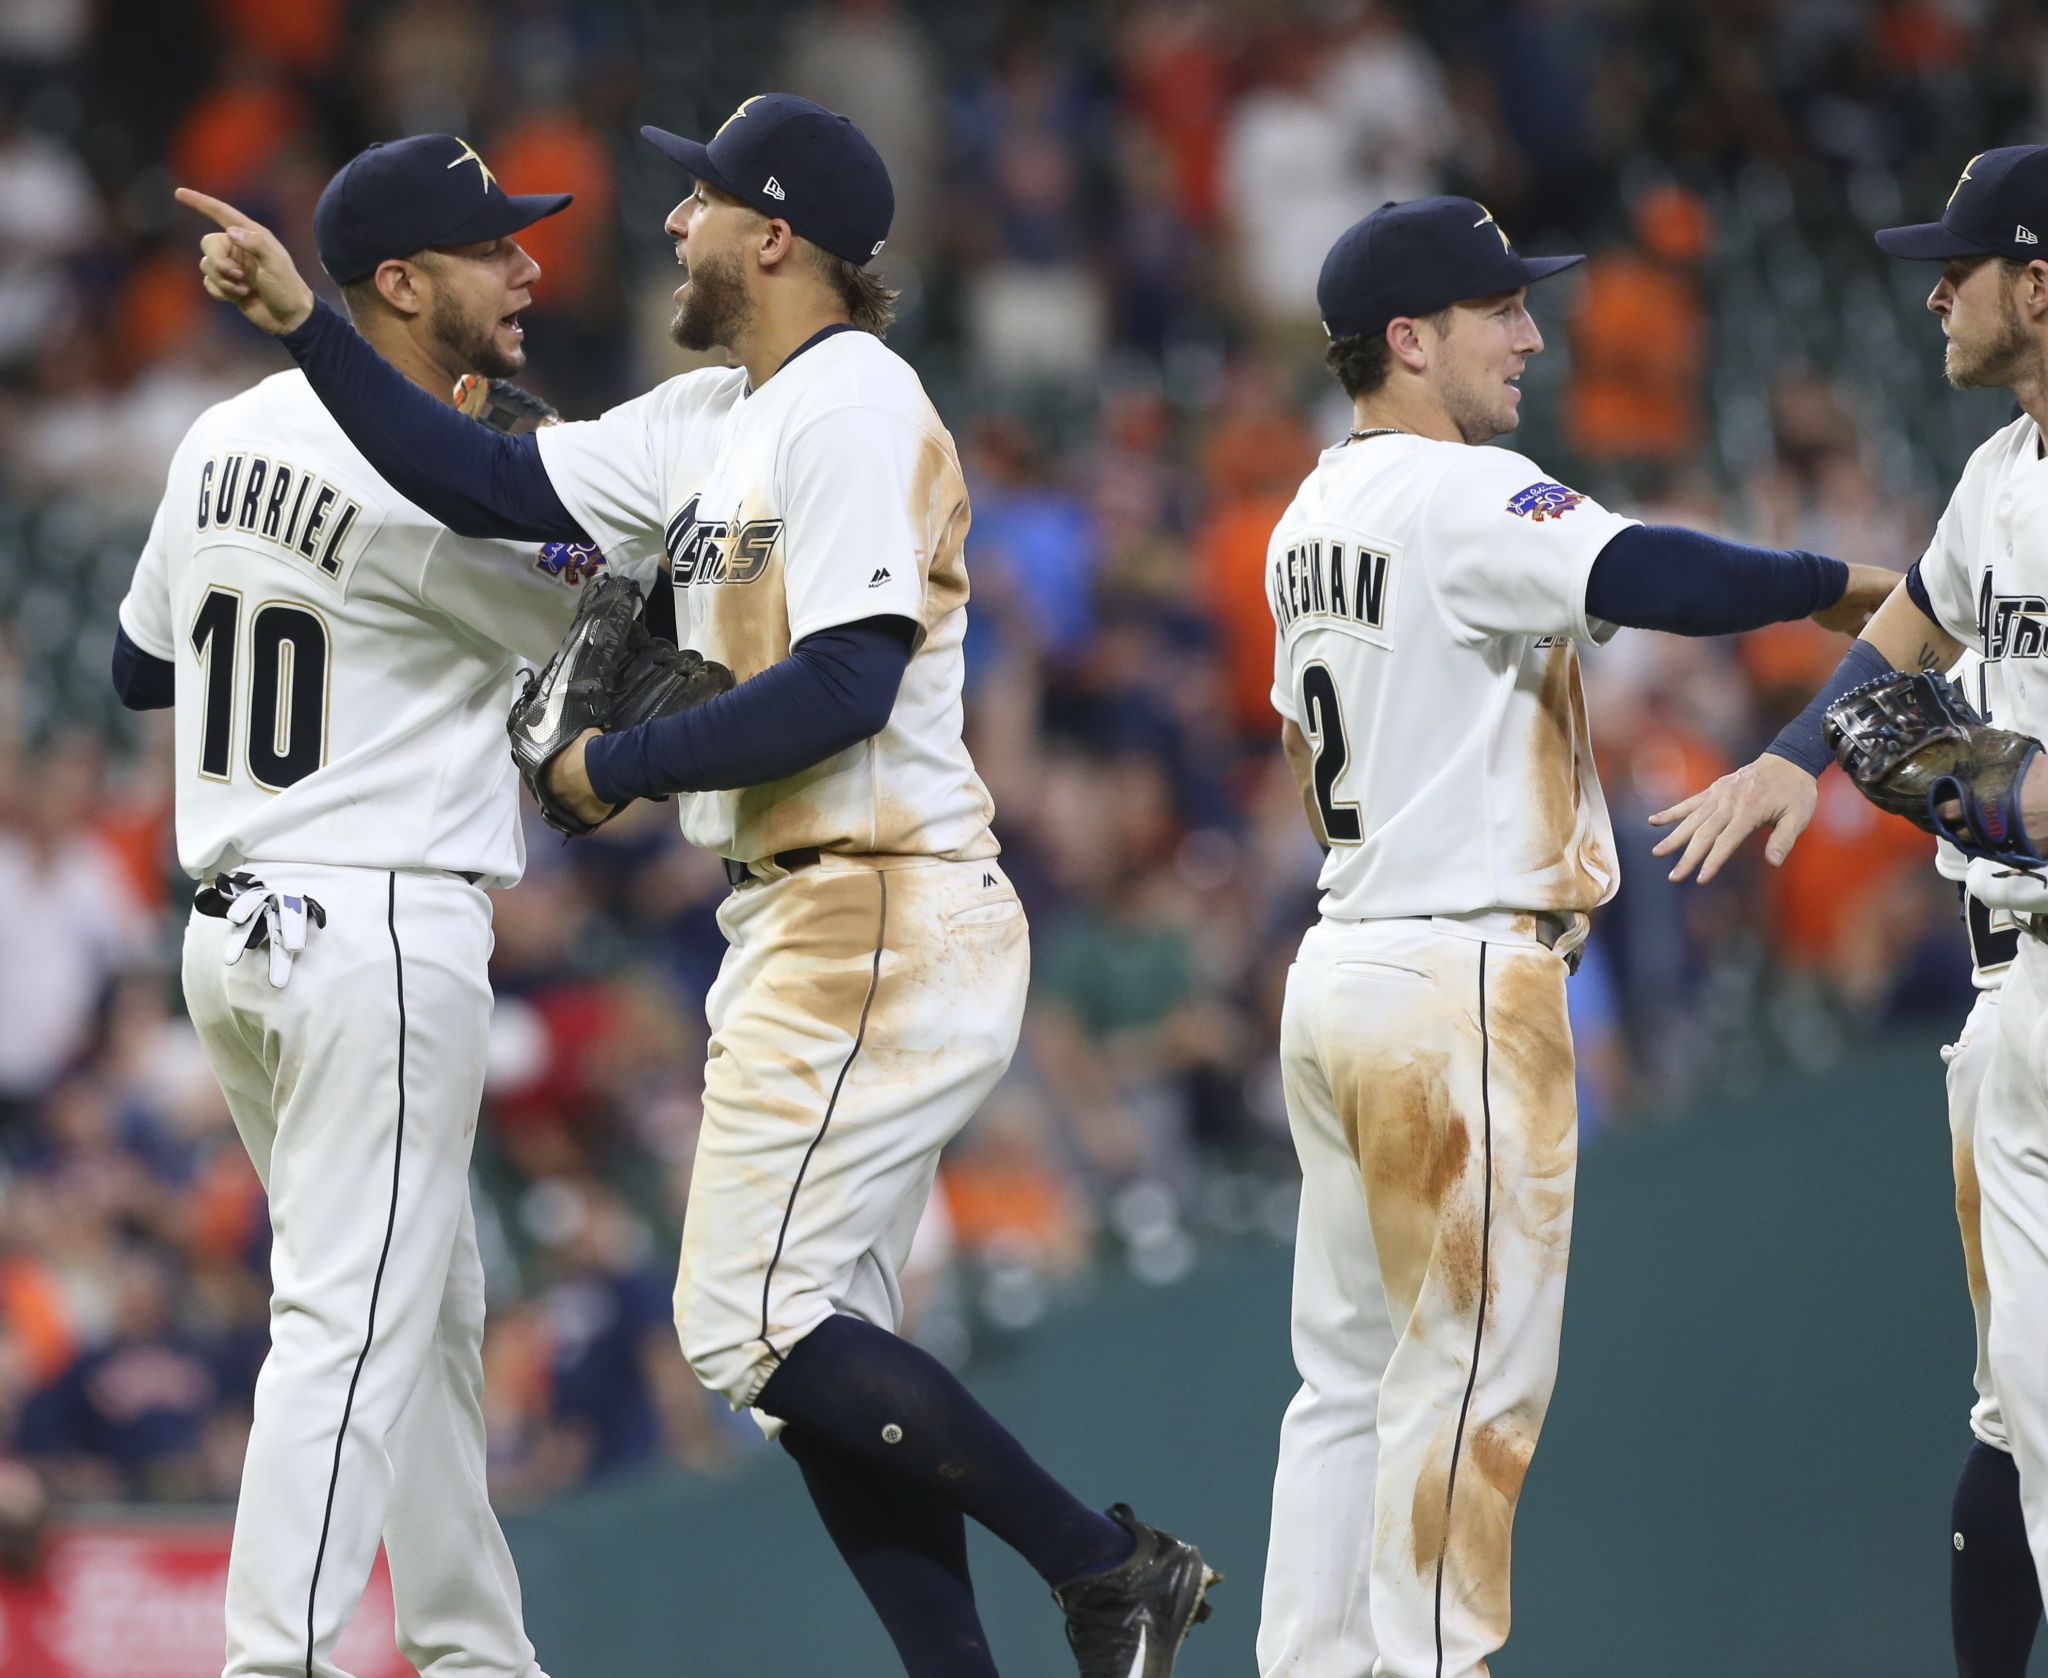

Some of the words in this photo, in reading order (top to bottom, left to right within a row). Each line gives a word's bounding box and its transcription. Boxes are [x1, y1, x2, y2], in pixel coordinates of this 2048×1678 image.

[196, 452, 362, 582] GURRIEL
[1534, 492, 1566, 510] 50
[1273, 538, 1391, 641] REGMAN
[189, 583, 332, 795] 10
[1299, 657, 1365, 848] 2
